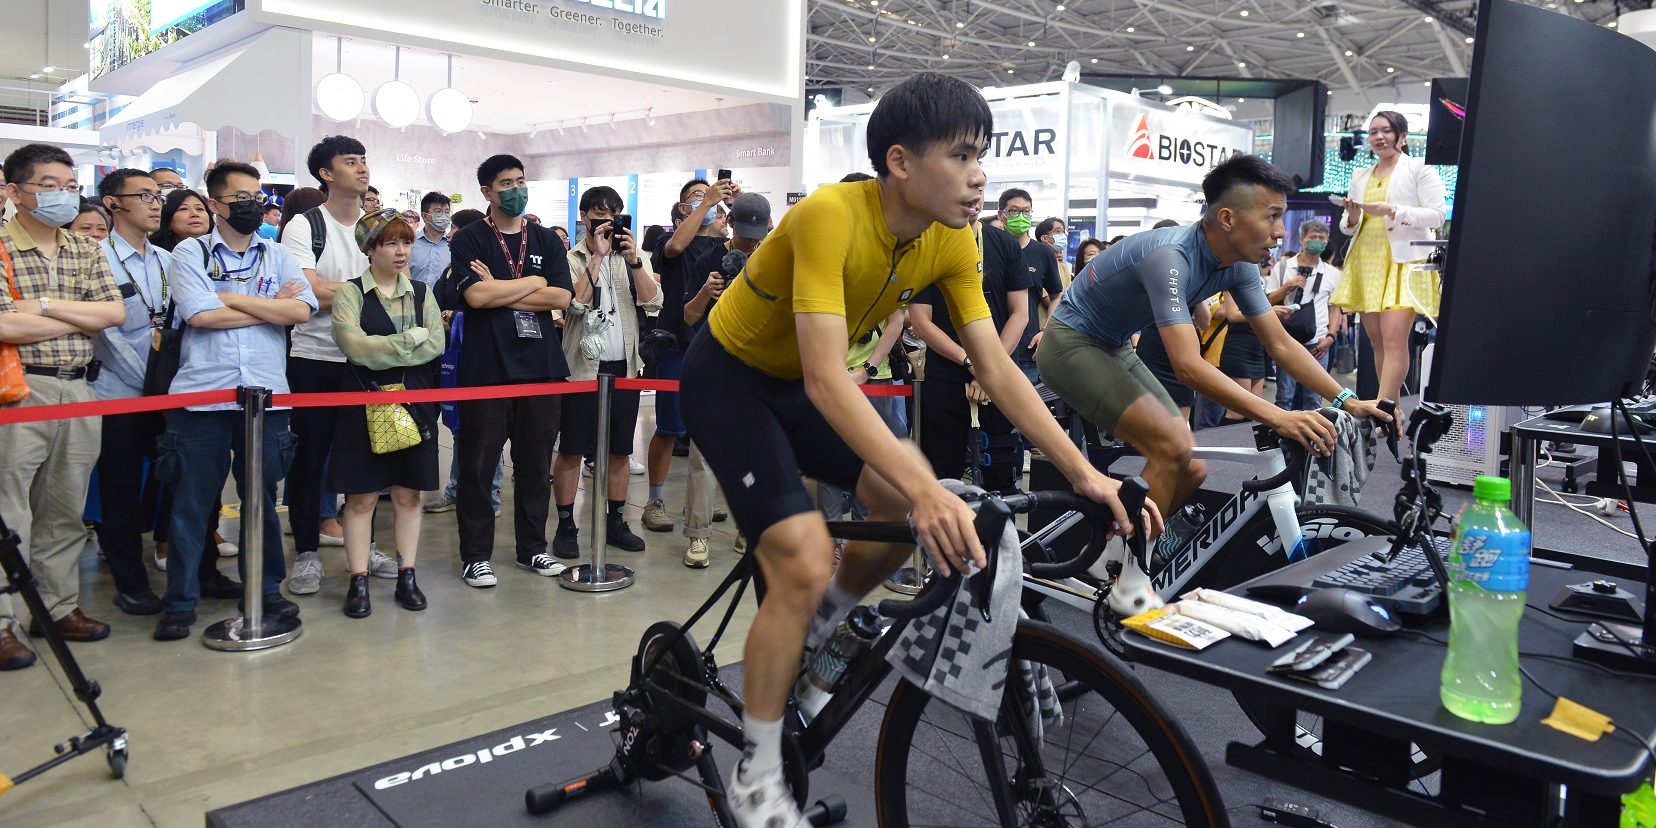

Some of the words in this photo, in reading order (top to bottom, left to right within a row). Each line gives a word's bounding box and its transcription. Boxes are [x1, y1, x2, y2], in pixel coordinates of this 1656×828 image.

[549, 6, 602, 26] Greener.
[611, 17, 664, 38] Together.
[396, 152, 412, 163] Life
[413, 154, 436, 165] Store
[736, 148, 757, 159] Smart
[757, 146, 776, 157] Bank
[570, 184, 576, 196] 3
[629, 182, 636, 194] 2
[1168, 268, 1181, 312] CHPT3
[1151, 475, 1259, 592] MERIDA
[374, 727, 562, 790] xplova
